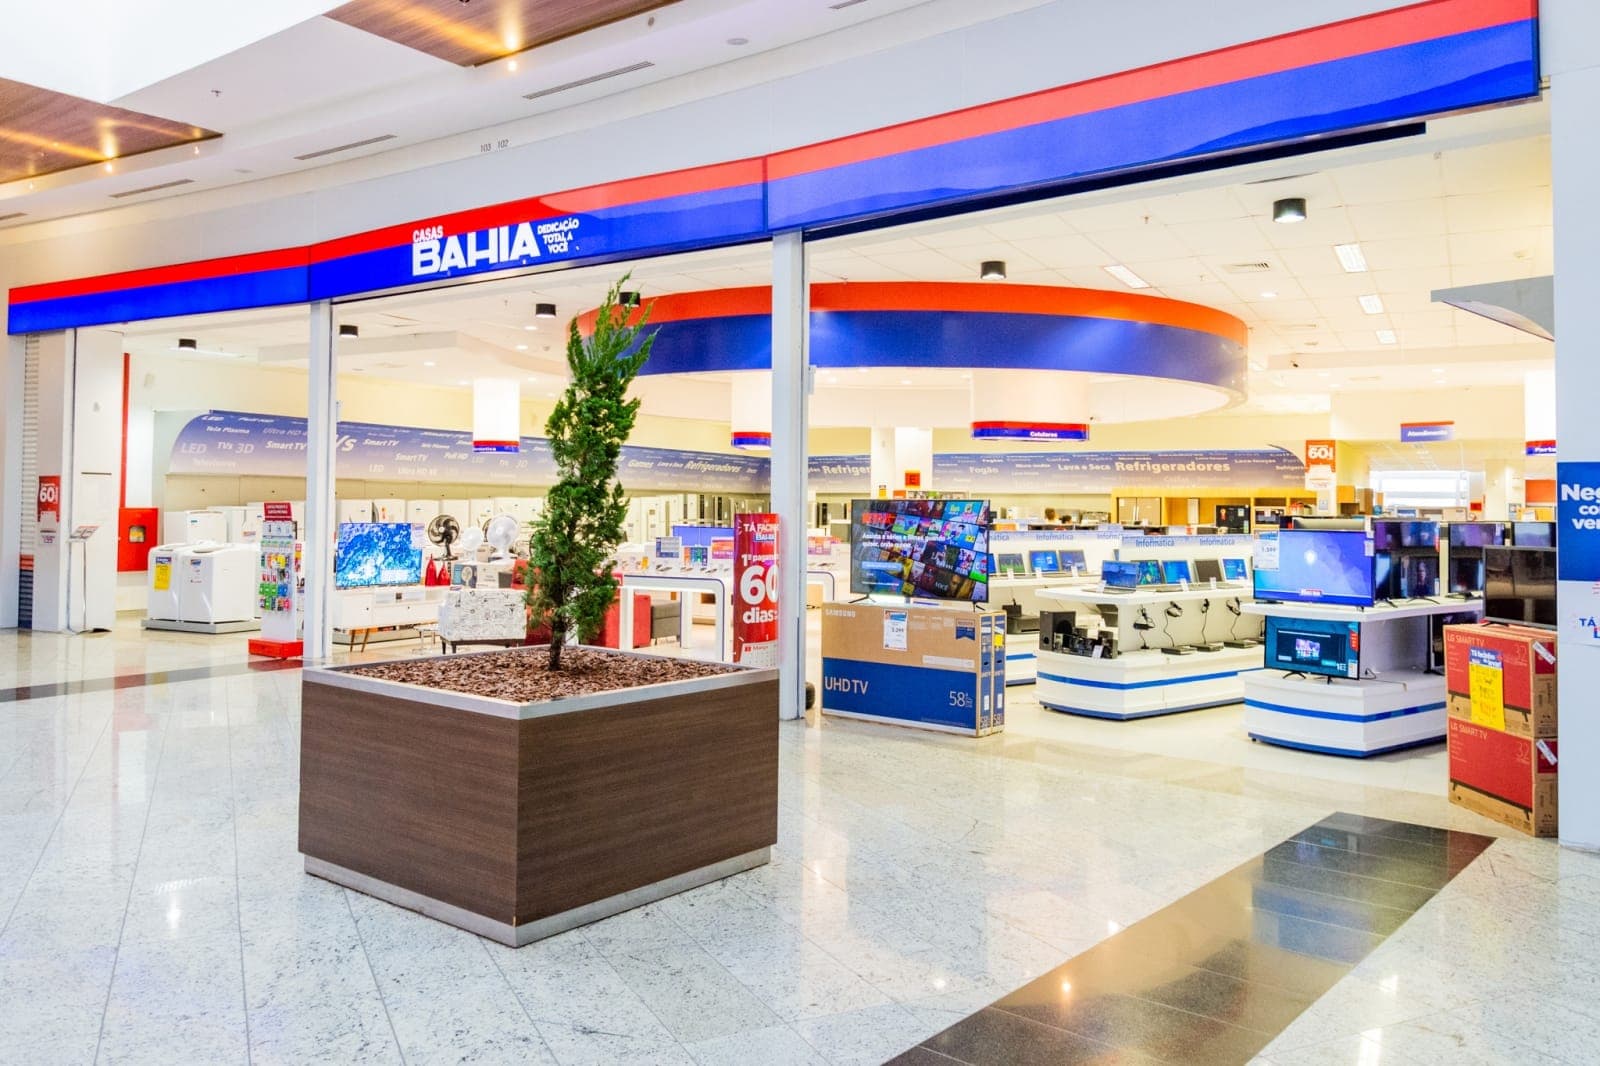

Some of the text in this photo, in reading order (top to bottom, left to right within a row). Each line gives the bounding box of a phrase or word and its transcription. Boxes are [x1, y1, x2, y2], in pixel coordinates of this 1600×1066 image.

[537, 217, 580, 235] DEDICAÇÃO
[413, 225, 444, 243] CASAS
[542, 231, 574, 244] TOTAL A
[412, 221, 541, 277] BAHIA
[548, 242, 569, 255] VOCÊ
[1029, 430, 1059, 439] Celulares
[234, 443, 255, 454] 3D
[264, 440, 294, 450] Smart
[684, 460, 743, 473] Refrigeradores
[968, 465, 1000, 476] Fogão
[1058, 463, 1080, 471] Lava
[1088, 463, 1112, 471] Seca
[1115, 461, 1231, 474] Refrigeradores
[1579, 504, 1600, 516] co
[1579, 616, 1596, 628] TÁ
[825, 675, 869, 695] UHD TV
[949, 690, 966, 707] 58
[1459, 724, 1478, 736] SMART
